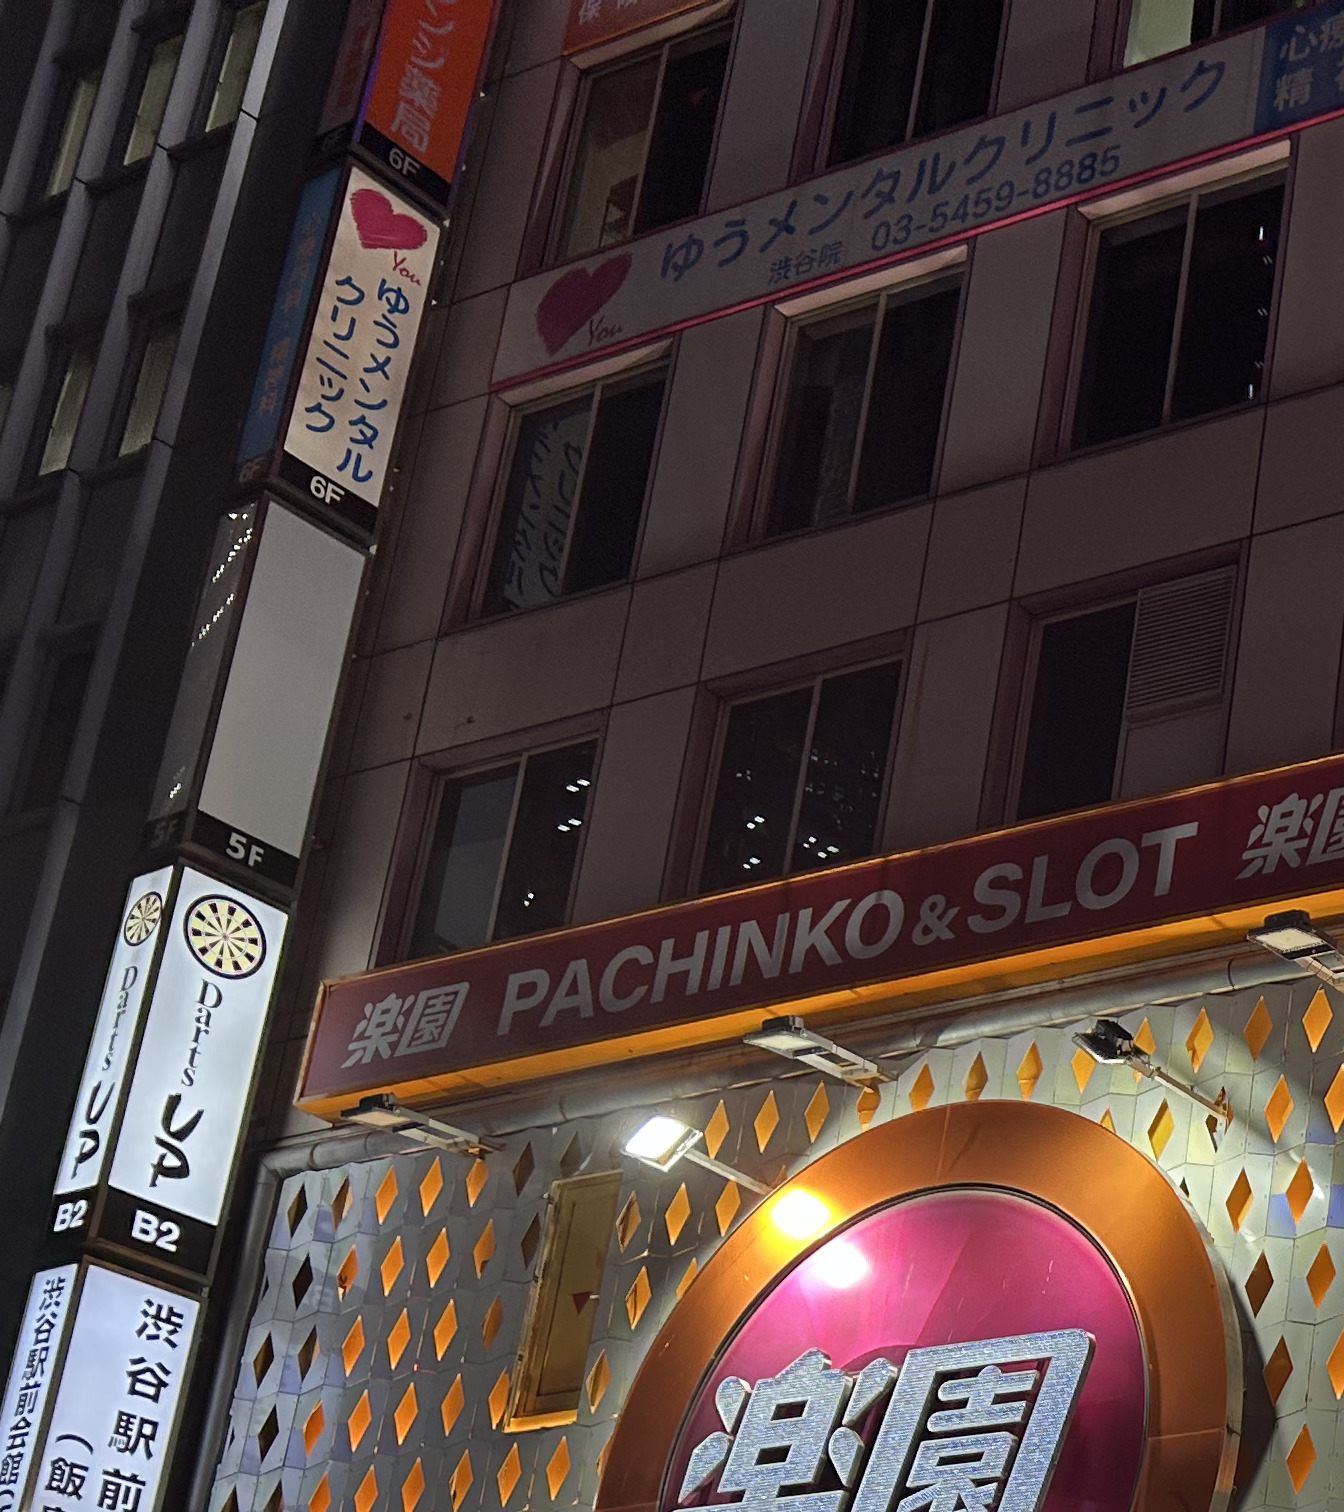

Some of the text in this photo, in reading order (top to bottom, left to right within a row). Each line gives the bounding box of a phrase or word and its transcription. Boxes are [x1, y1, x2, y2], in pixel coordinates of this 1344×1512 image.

[388, 150, 420, 177] 6F
[661, 59, 1226, 282] ゆうメンタルクリニック
[871, 145, 1122, 251] 03-5459-8885
[768, 242, 844, 286] 渋谷院
[305, 276, 365, 433] クリニック
[337, 279, 410, 482] ゆうメンタル
[309, 475, 345, 504] 6F
[226, 832, 264, 868] 5F
[102, 966, 139, 1071] Darts
[181, 979, 223, 1087] Darts
[341, 979, 469, 1069] 楽園
[149, 1093, 204, 1188] UP
[53, 1199, 88, 1232] B2
[131, 1209, 182, 1252] B2
